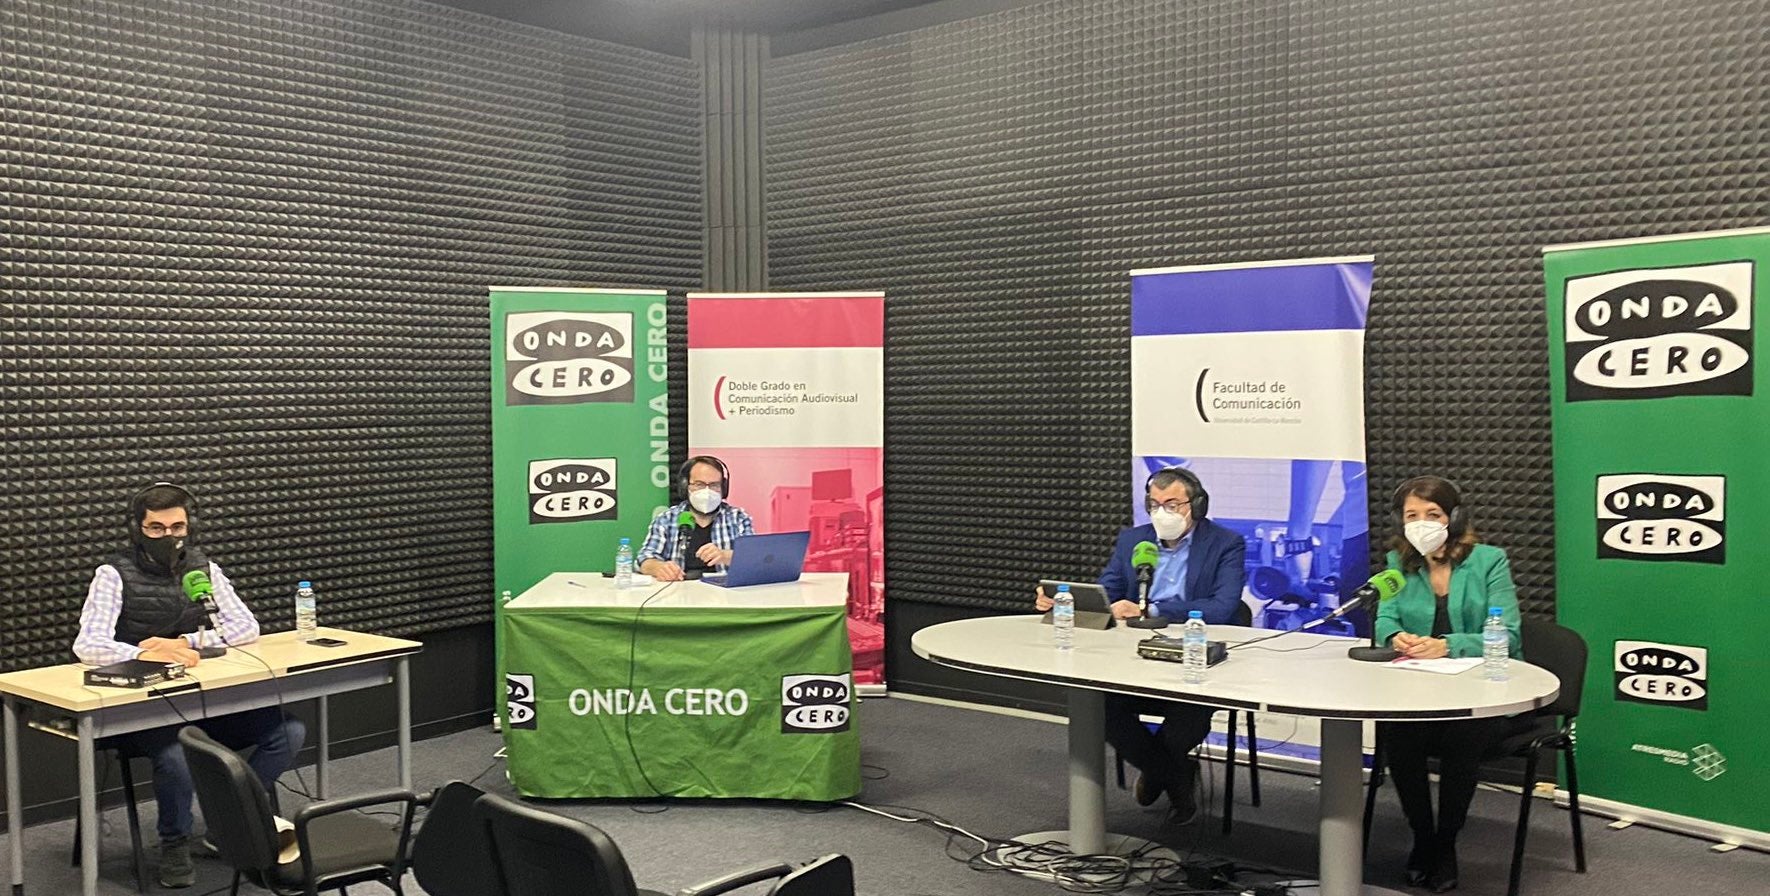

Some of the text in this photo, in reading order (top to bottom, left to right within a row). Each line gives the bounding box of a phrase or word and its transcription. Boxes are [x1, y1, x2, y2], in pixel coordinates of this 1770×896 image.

[1588, 292, 1724, 327] ONDA
[523, 330, 615, 350] ONDA
[647, 302, 668, 382] CERO
[1598, 345, 1723, 377] CERO
[529, 366, 615, 388] CERO
[728, 381, 806, 391] Doble Grado en
[1213, 381, 1286, 393] Facultad de
[728, 393, 858, 404] Comunicación Audiovisual
[1212, 397, 1301, 409] Comunicación
[739, 405, 795, 415] Periodismo
[649, 393, 670, 488] ONDA
[540, 471, 604, 487] ONDA
[545, 496, 604, 512] CERO
[1613, 491, 1705, 511] ONDA
[1620, 526, 1702, 547] CERO
[1625, 653, 1694, 672] ONDA
[506, 684, 525, 697] DA
[792, 686, 845, 699] ONDA
[1631, 678, 1692, 697] CERO
[568, 688, 749, 716] ONDA CERO
[508, 706, 526, 719] RO
[796, 709, 845, 723] CERO
